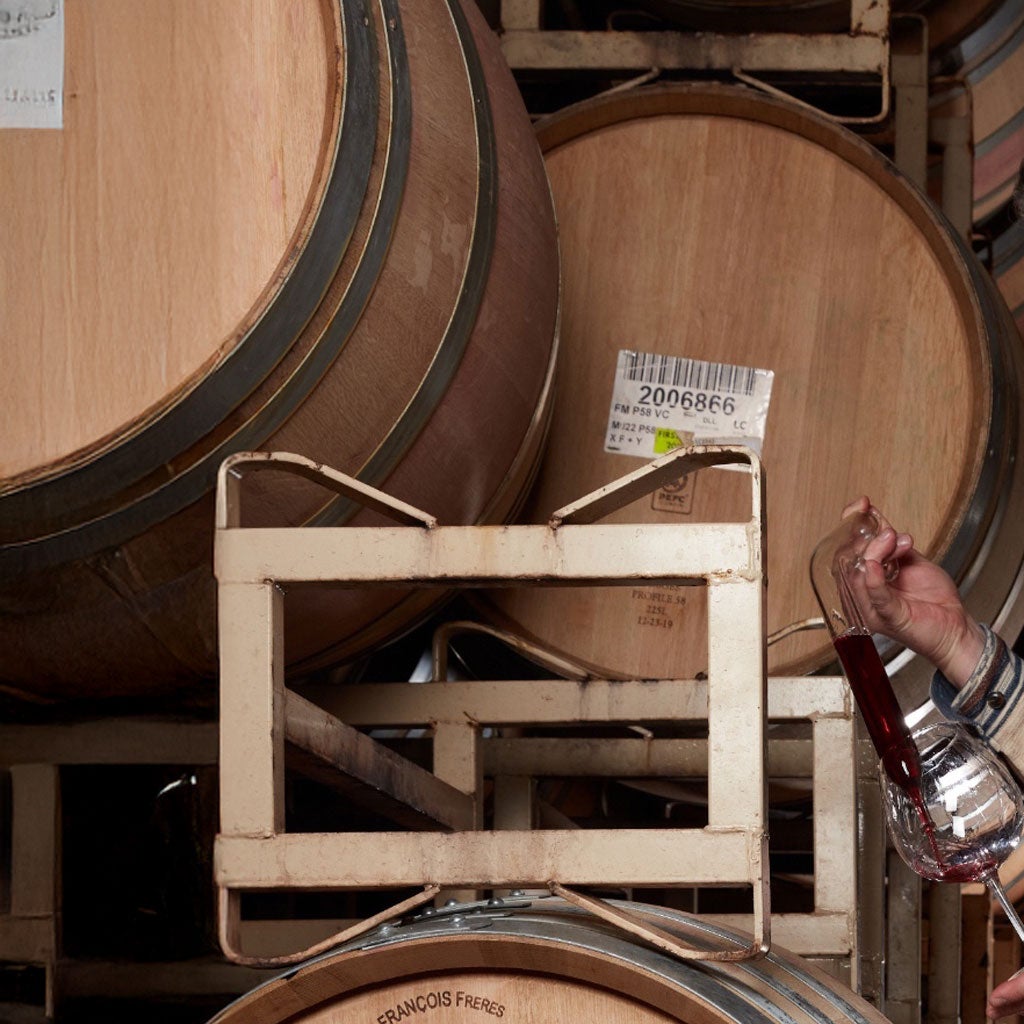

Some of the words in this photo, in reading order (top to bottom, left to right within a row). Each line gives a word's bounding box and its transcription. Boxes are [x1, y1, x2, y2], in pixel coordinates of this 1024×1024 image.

[638, 385, 736, 415] 2006866
[614, 404, 630, 414] FM
[632, 406, 652, 417] P58
[655, 409, 670, 419] VC
[610, 434, 616, 442] X
[632, 590, 673, 603] PROFILE
[456, 991, 506, 1018] FRERES
